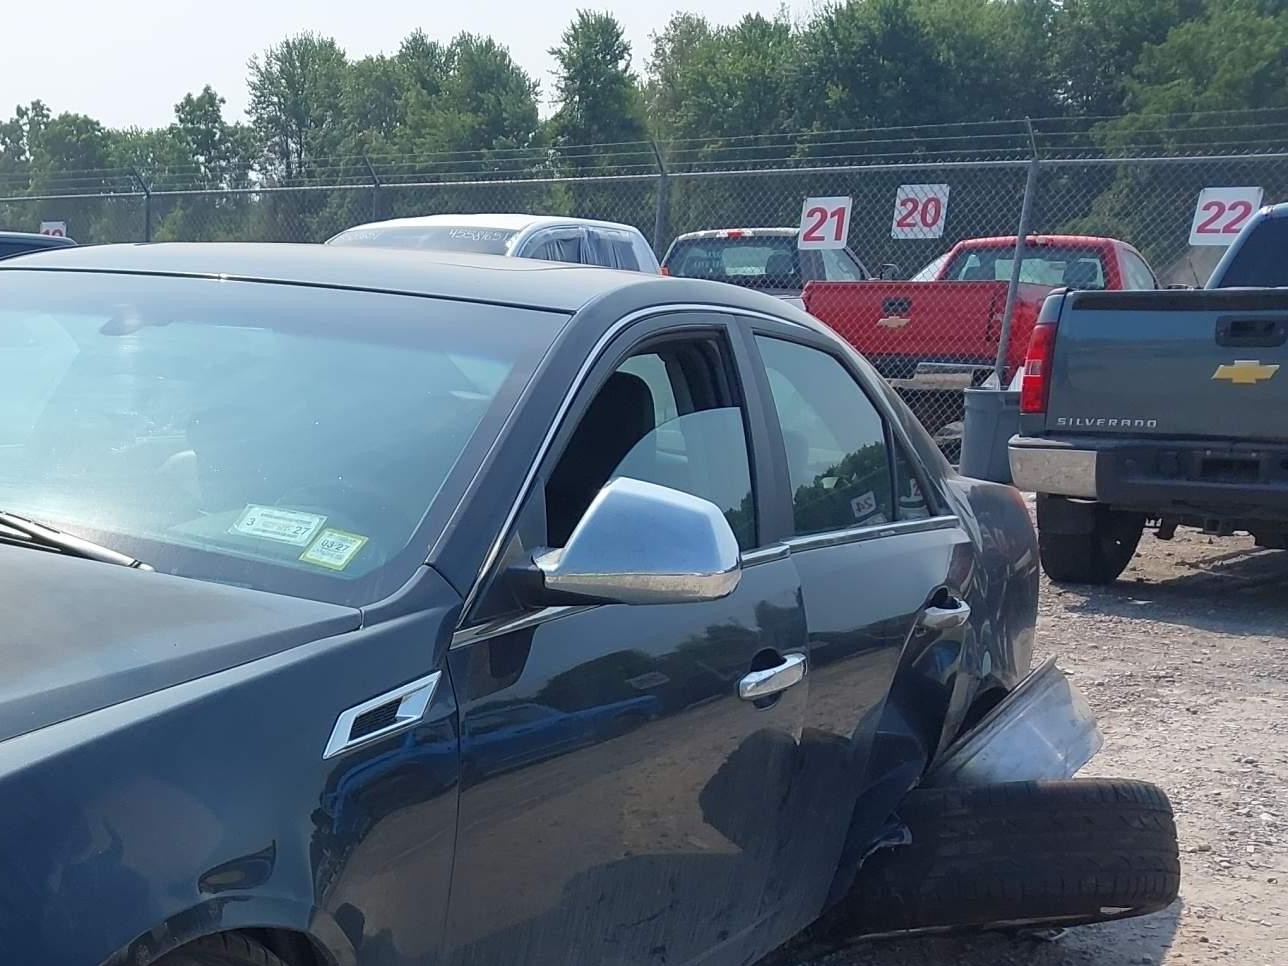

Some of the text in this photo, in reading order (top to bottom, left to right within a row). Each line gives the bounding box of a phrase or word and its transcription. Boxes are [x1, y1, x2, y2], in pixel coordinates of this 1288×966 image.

[802, 207, 846, 241] 21
[896, 197, 941, 228] 20
[1196, 201, 1252, 233] 22
[1057, 417, 1157, 428] SILVERADO
[292, 526, 312, 535] 27
